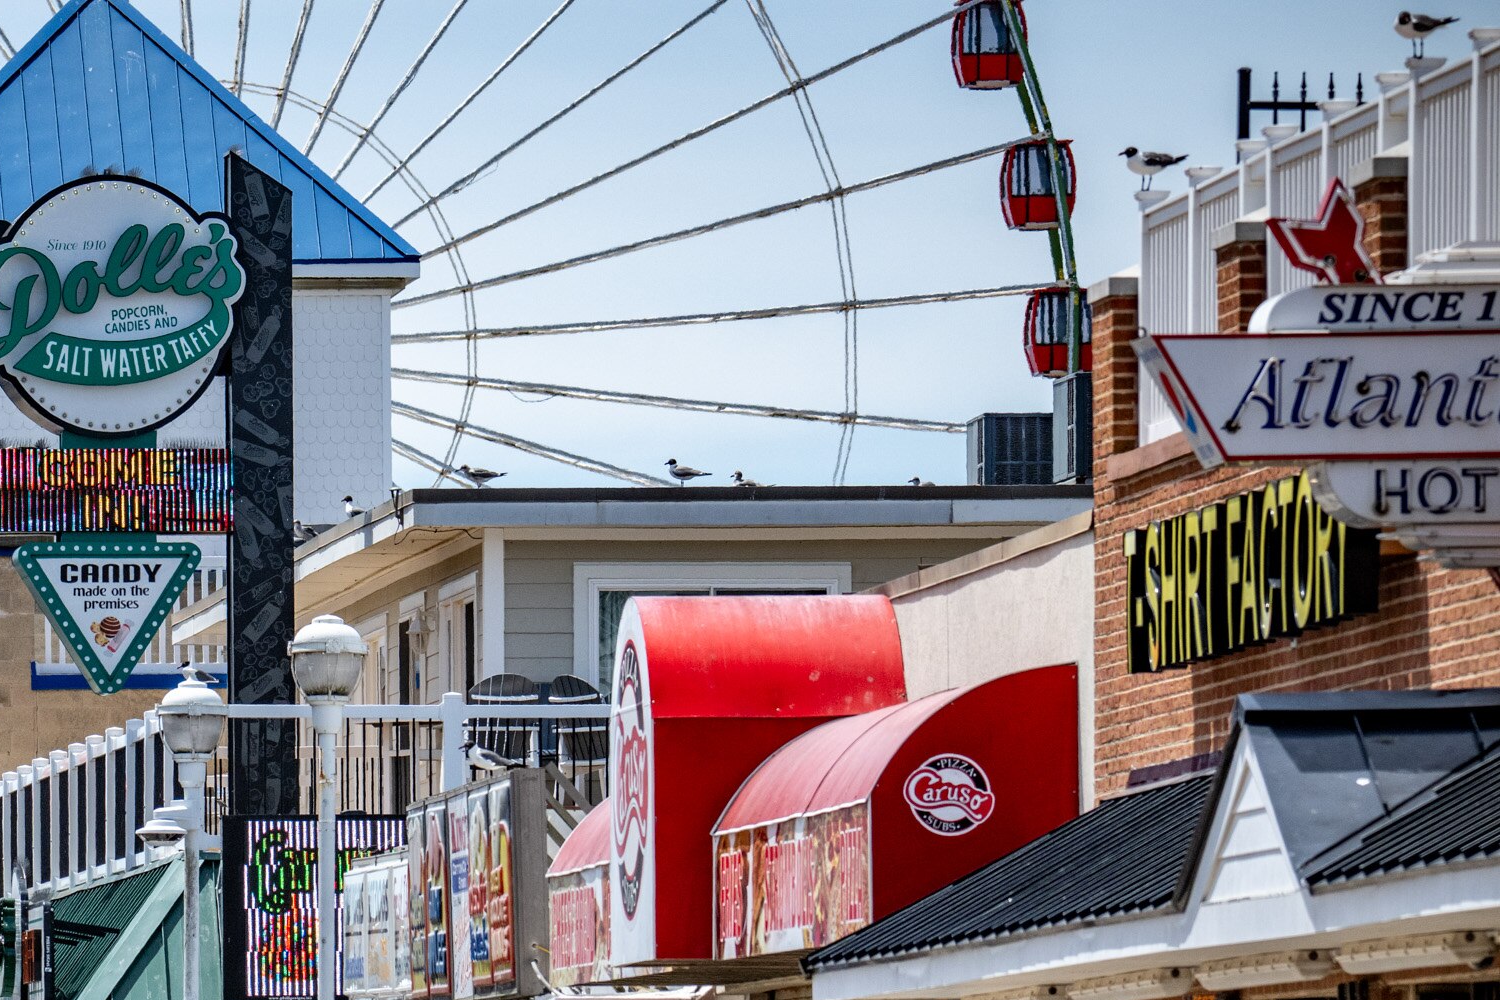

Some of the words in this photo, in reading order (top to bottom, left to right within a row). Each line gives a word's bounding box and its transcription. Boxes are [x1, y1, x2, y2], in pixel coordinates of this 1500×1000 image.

[47, 239, 78, 250] Since
[83, 239, 107, 250] 1910
[111, 304, 168, 321] POPCORN,
[1318, 291, 1465, 324] SINCE
[104, 319, 150, 335] CANDIES
[154, 316, 178, 328] AND
[43, 340, 93, 377] SALT
[100, 343, 169, 378] WATER
[168, 319, 219, 364] TAFFY
[1221, 355, 1500, 431] Atlant
[60, 563, 163, 583] CANDY
[73, 585, 107, 597] made
[111, 587, 127, 597] on
[130, 584, 150, 596] the
[1123, 505, 1218, 674] T-SHIRT
[84, 599, 140, 612] premises
[940, 758, 974, 778] PIZZA
[908, 772, 989, 815] Caruso
[927, 815, 957, 832] SUBS
